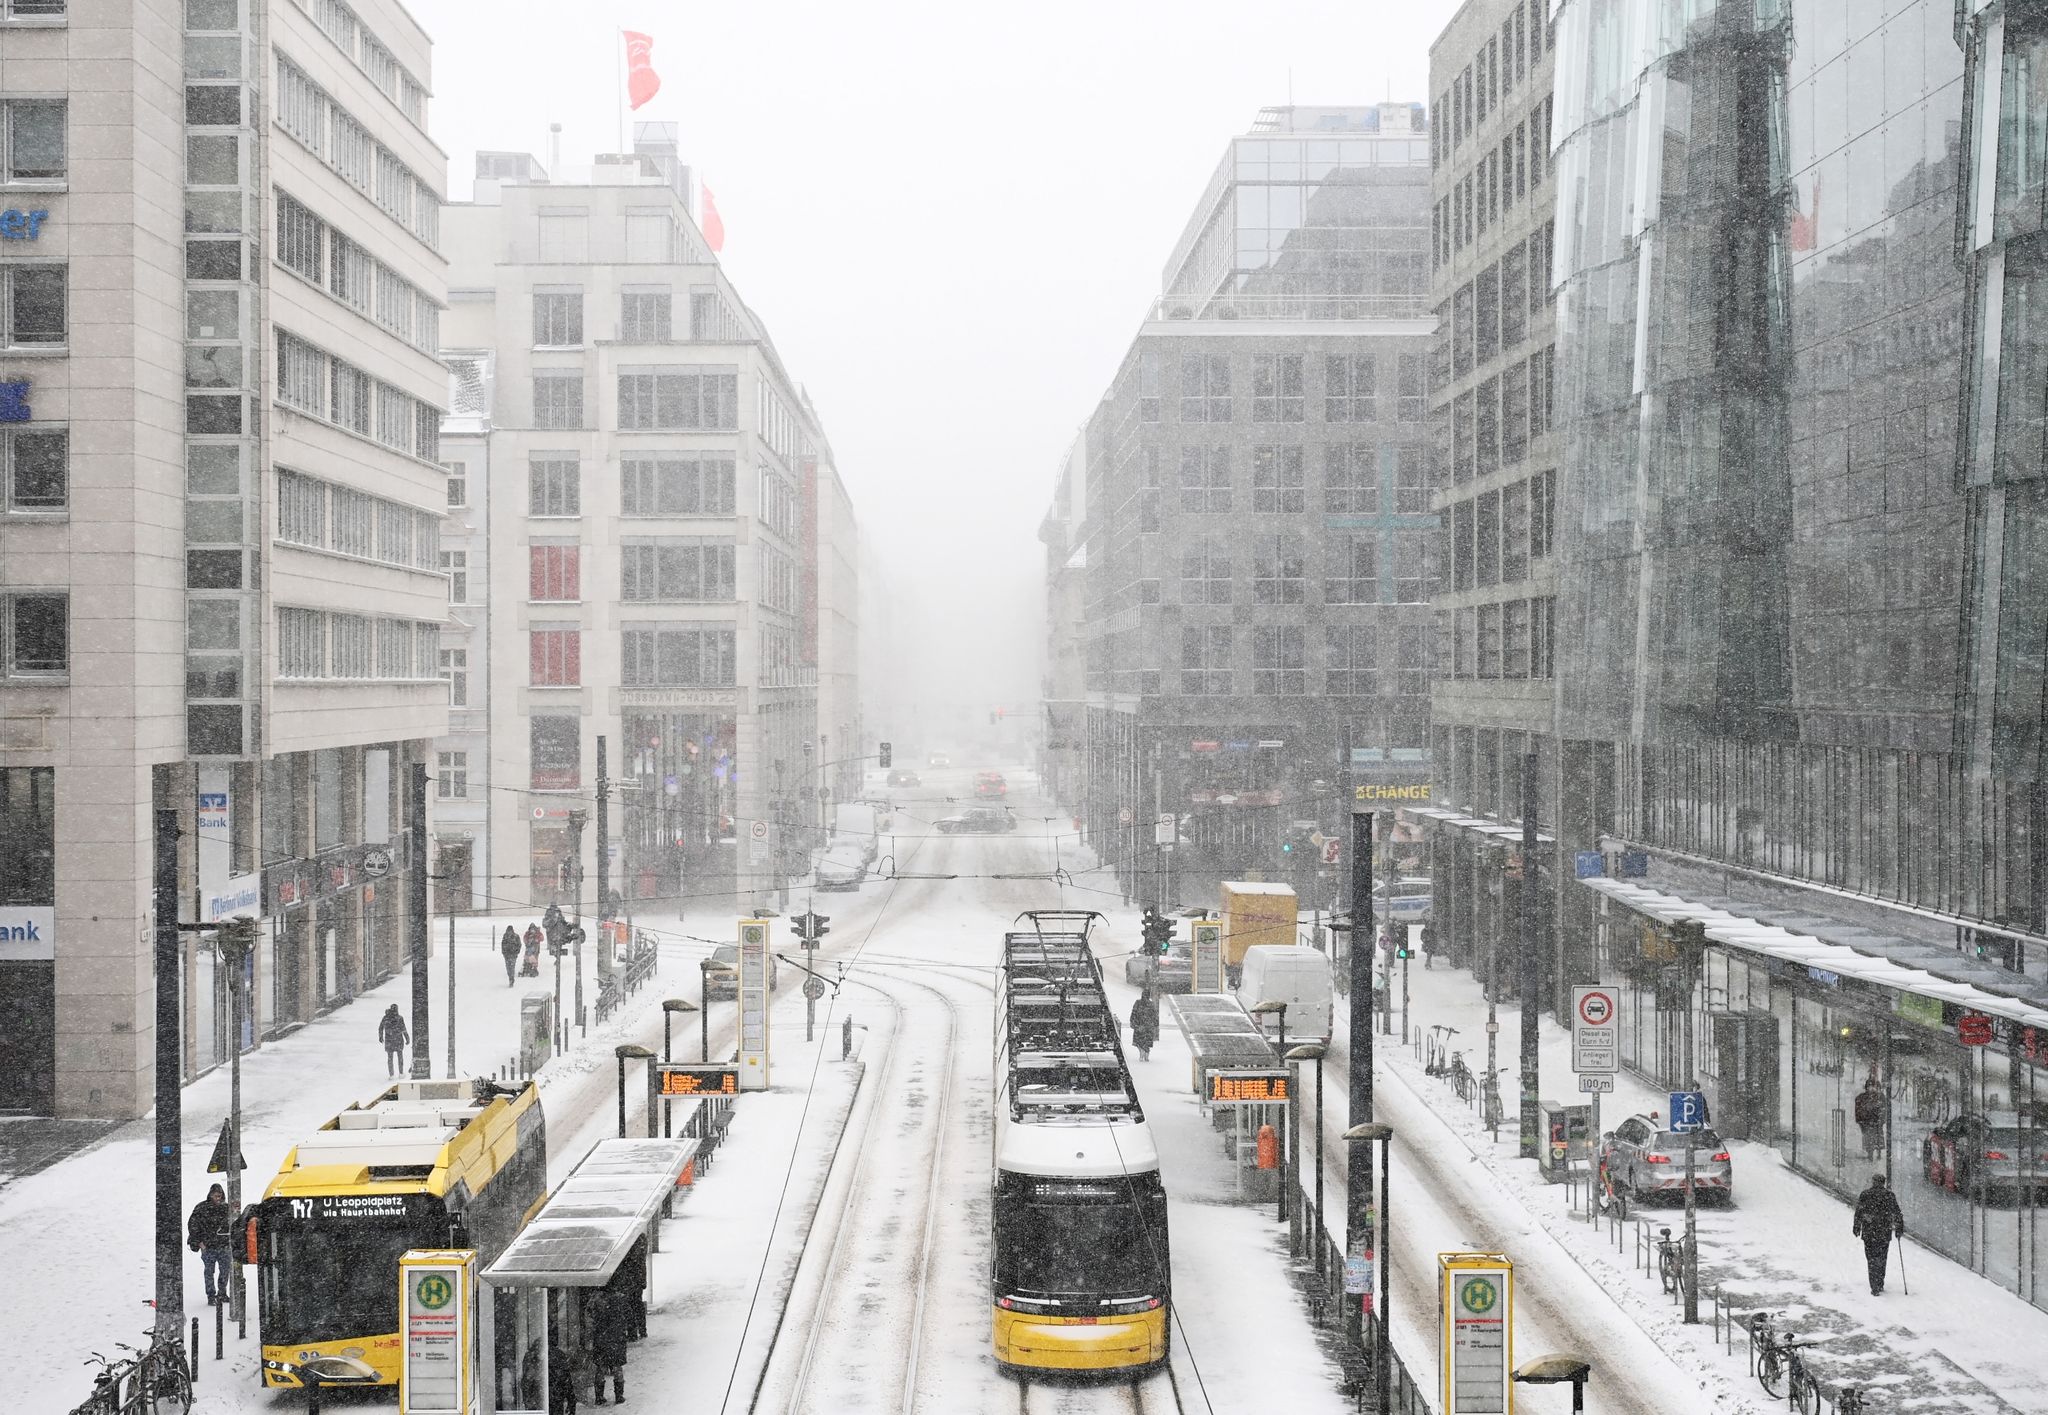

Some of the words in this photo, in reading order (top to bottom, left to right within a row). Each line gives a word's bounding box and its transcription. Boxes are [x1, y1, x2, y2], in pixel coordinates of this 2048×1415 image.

[199, 817, 227, 828] Bank
[1582, 1078, 1599, 1089] 100
[1683, 1101, 1696, 1123] P
[290, 1198, 313, 1219] 147
[323, 1198, 332, 1207] U
[335, 1196, 403, 1208] Leopoldplatz
[323, 1208, 337, 1217] via
[341, 1206, 407, 1217] Hauptbahnhof
